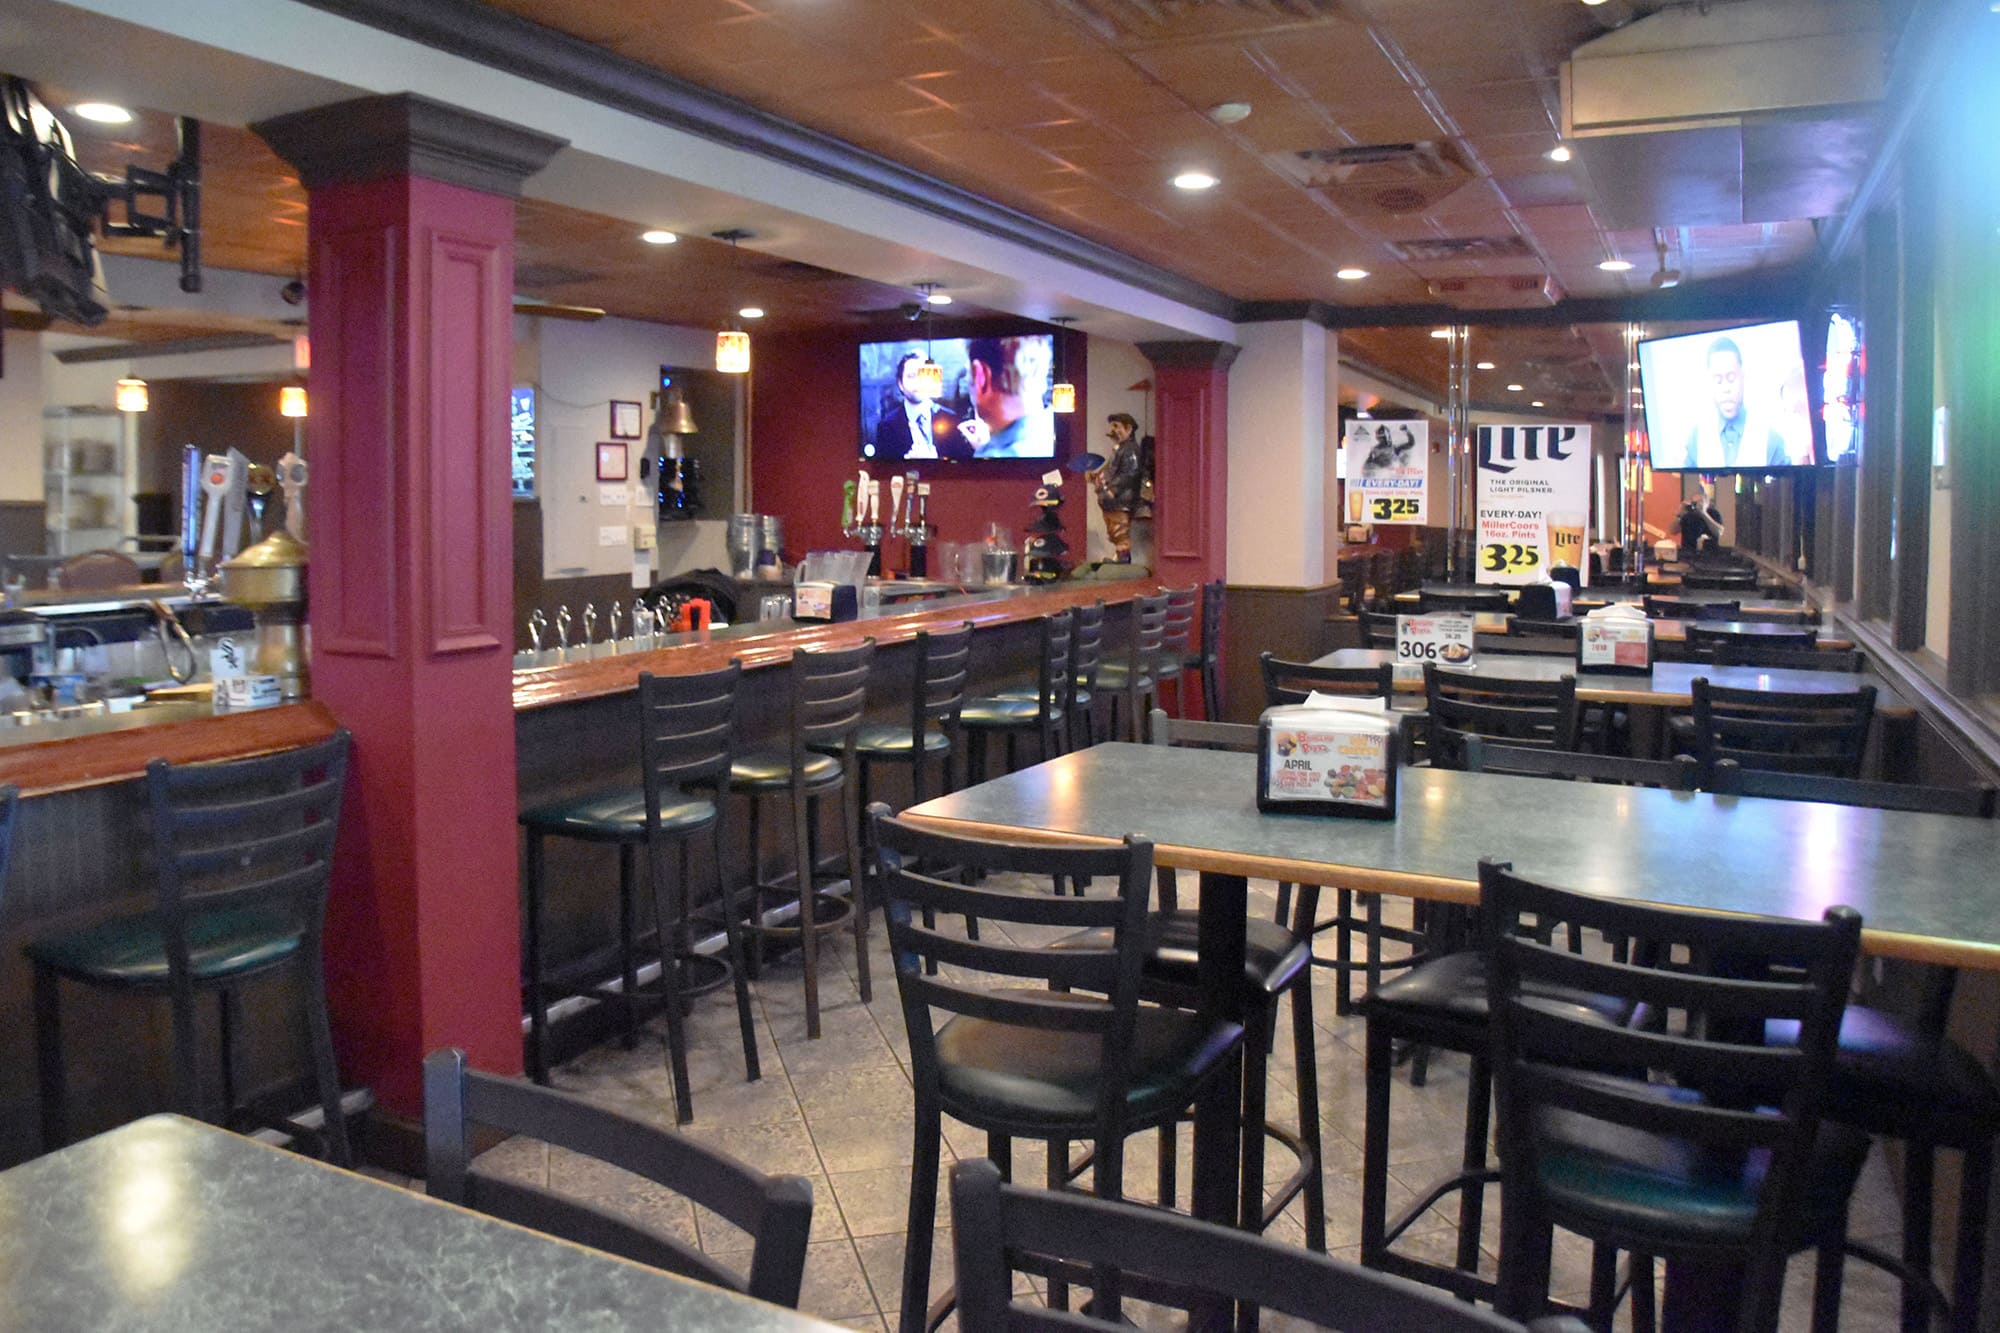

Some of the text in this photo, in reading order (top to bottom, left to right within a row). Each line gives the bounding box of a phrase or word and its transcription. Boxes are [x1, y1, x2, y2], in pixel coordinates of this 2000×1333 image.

[1480, 510, 1542, 519] EVERY-DAY!
[1482, 521, 1540, 530] MillerCoors
[1485, 530, 1537, 539] 16oz. Pints
[1555, 531, 1581, 548] Lite
[1399, 640, 1437, 659] 306
[1283, 759, 1313, 771] APRIL
